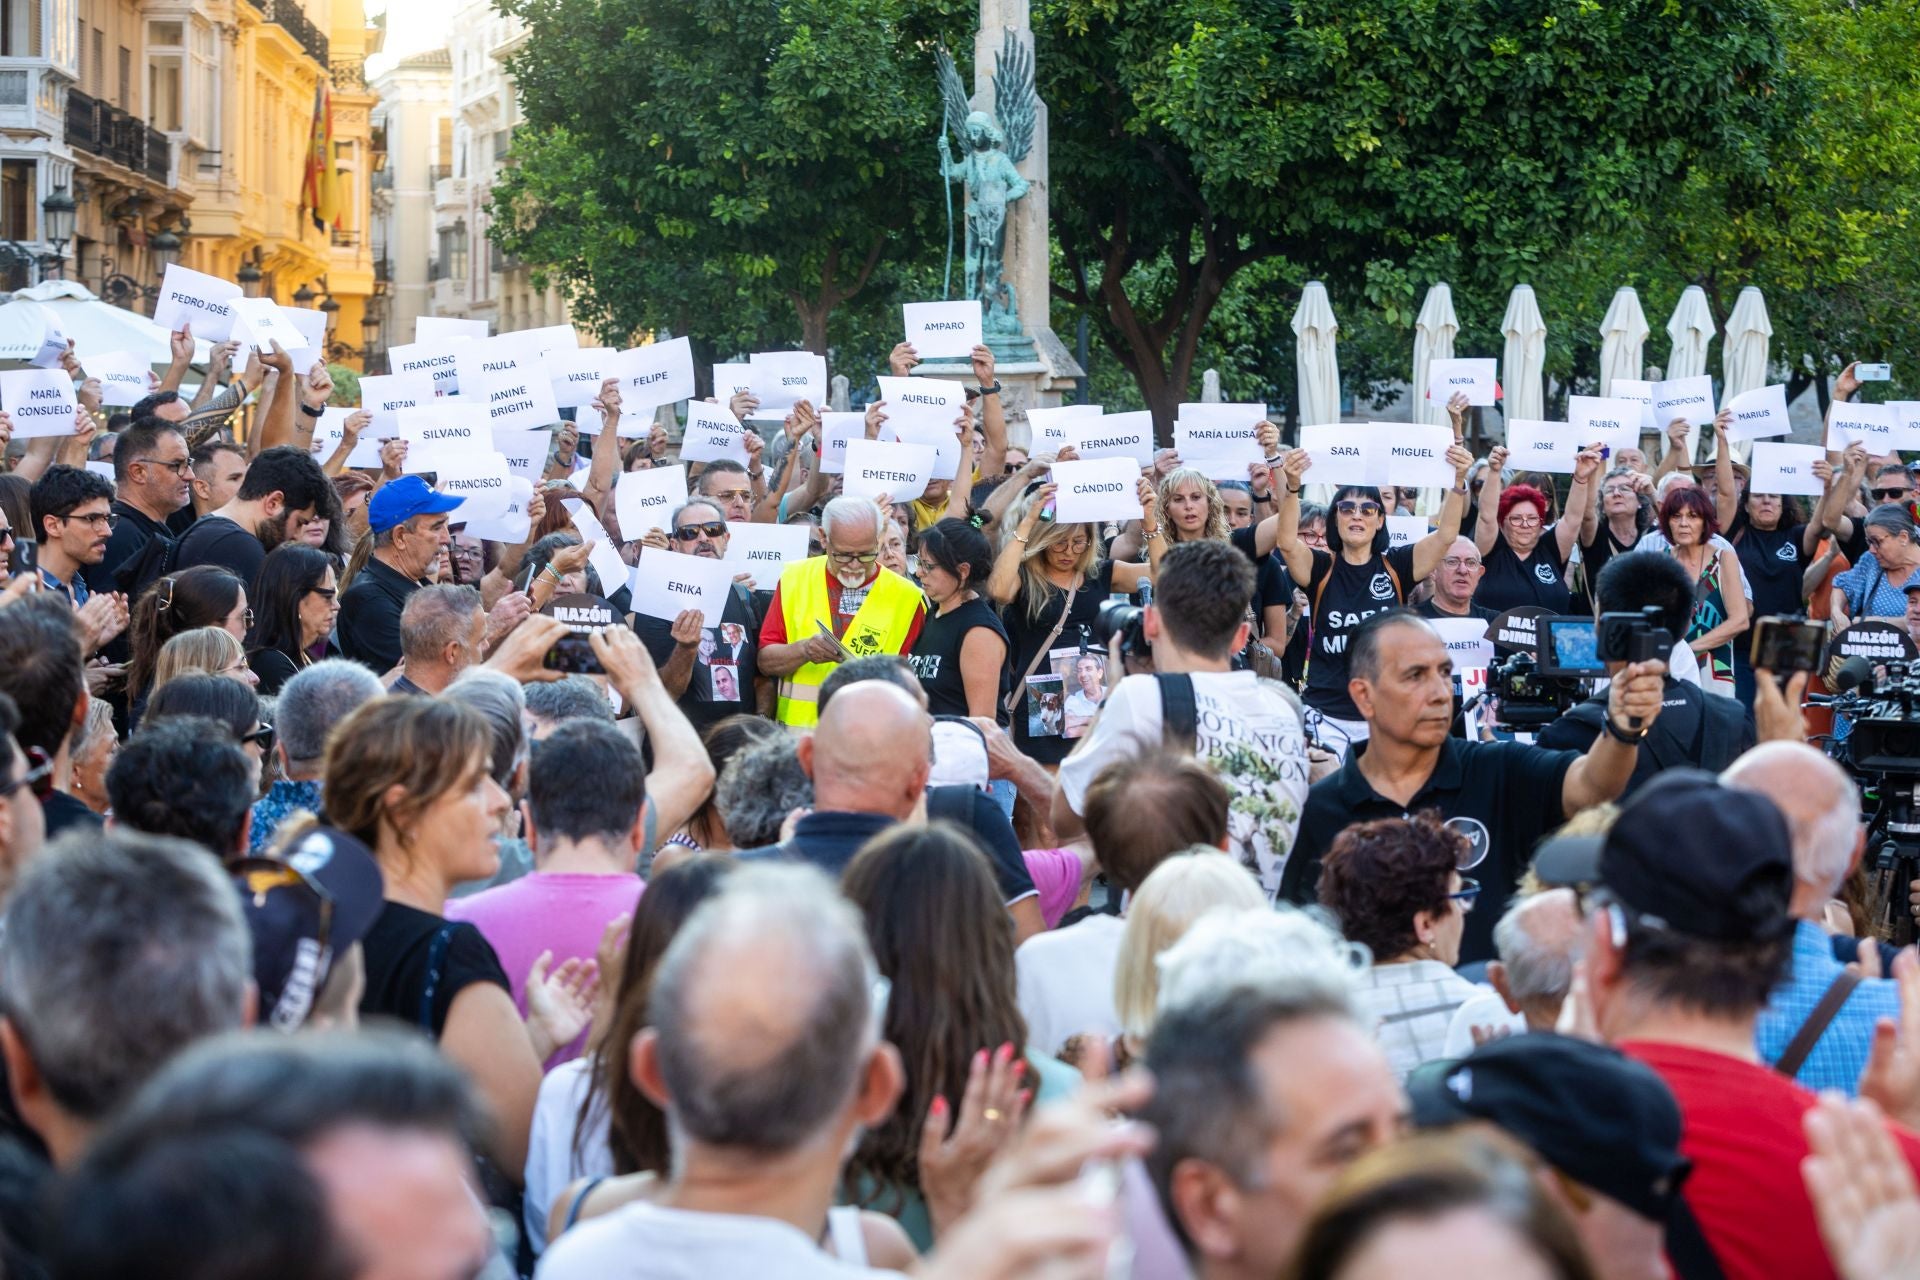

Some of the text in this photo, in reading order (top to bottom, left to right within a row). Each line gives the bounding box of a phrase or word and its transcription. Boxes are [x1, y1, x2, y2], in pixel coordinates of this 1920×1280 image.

[172, 292, 230, 316] PEDRO JOSÉ
[924, 321, 965, 332] AMPARO
[482, 360, 516, 372] PAULA
[106, 373, 142, 385] LUCIANO
[568, 372, 600, 382] VASILE
[633, 370, 668, 386] FELIPE
[782, 376, 808, 386] SERGIO
[30, 387, 62, 400] MARÍA
[490, 386, 528, 402] JANINE
[902, 394, 946, 406] AURELIO
[18, 405, 72, 417] CONSUELO
[490, 400, 534, 418] BRIGITH
[1738, 410, 1770, 420] MARIUS
[1188, 428, 1255, 438] MARÍA LUISA
[1836, 420, 1889, 434] MARÍA PILAR
[423, 428, 471, 440] SILVANO
[1045, 429, 1062, 438] EVA
[708, 436, 730, 446] JOSÉ
[1080, 435, 1140, 450] FERNANDO
[1330, 446, 1360, 456] SARA
[1392, 447, 1434, 458] MIGUEL
[862, 469, 916, 482] EMETERIO
[1780, 466, 1796, 474] HUI
[448, 478, 502, 490] FRANCISCO
[1074, 482, 1124, 494] CÁNDIDO
[641, 495, 668, 508] ROSA
[746, 550, 782, 561] JAVIER
[668, 582, 702, 596] ERIKA
[554, 605, 612, 623] MAZÓN
[1847, 630, 1900, 644] MAZÓN
[1841, 644, 1906, 658] DIMISSIÓ
